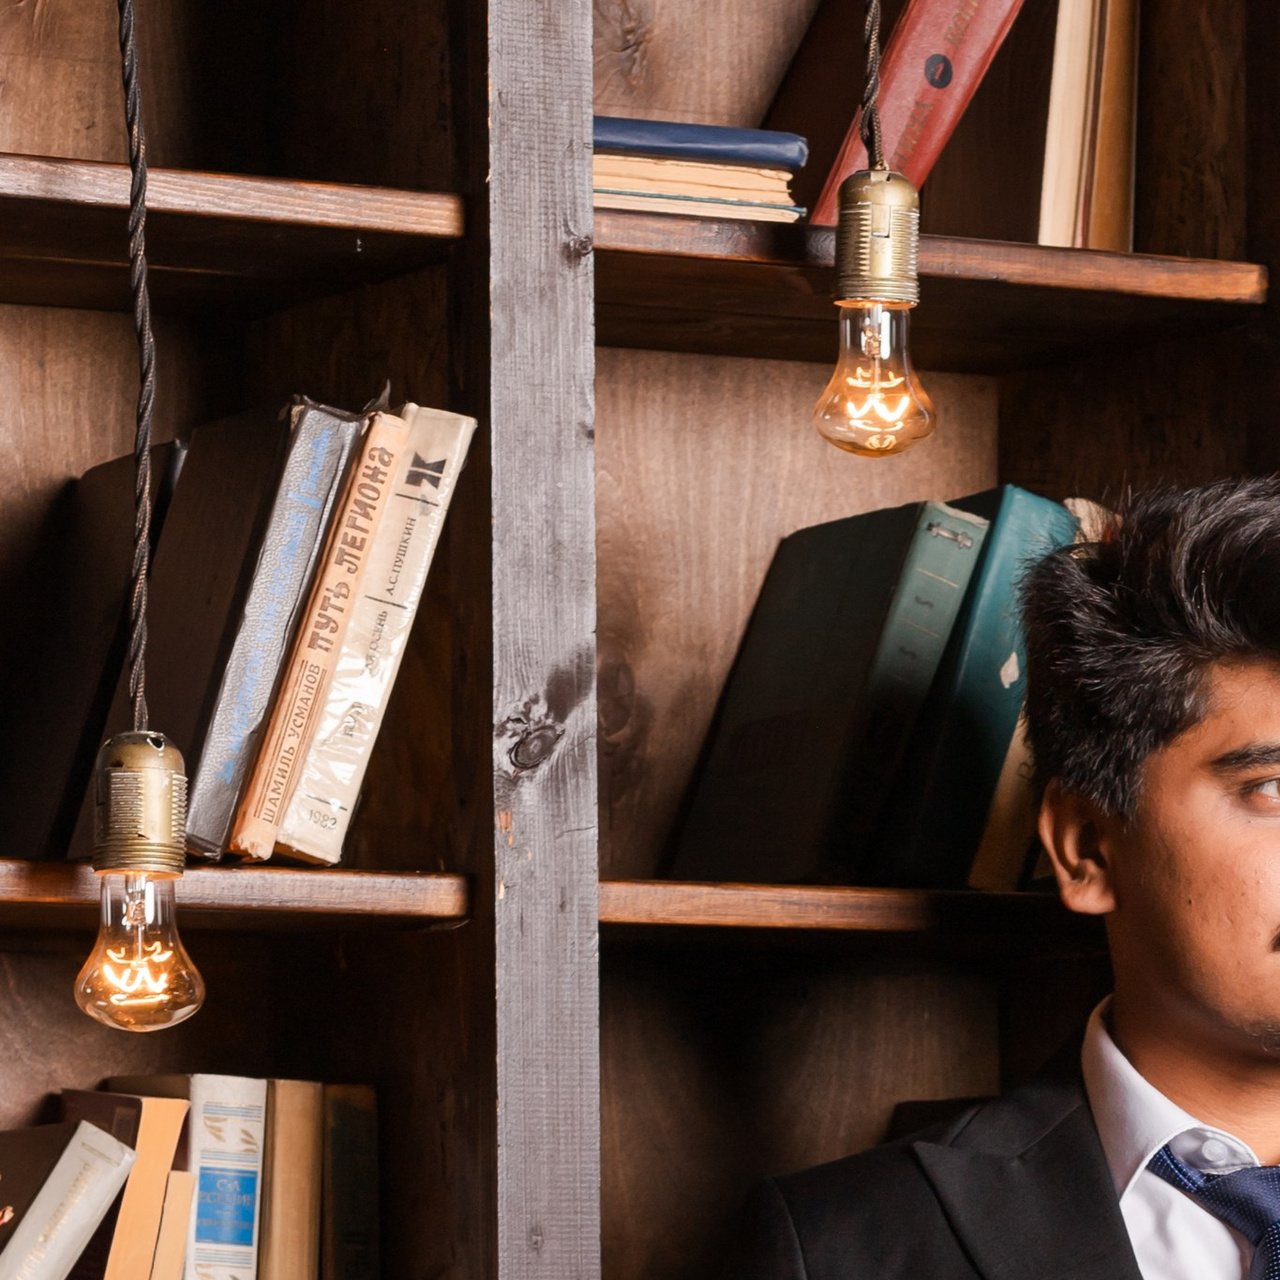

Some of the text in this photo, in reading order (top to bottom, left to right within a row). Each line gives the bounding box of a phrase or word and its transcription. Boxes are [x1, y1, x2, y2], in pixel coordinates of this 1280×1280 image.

[308, 446, 394, 654] ПУТЬ ЛЕГИОНА
[262, 664, 321, 823] ШАМИЛЬ УСМАНОВ
